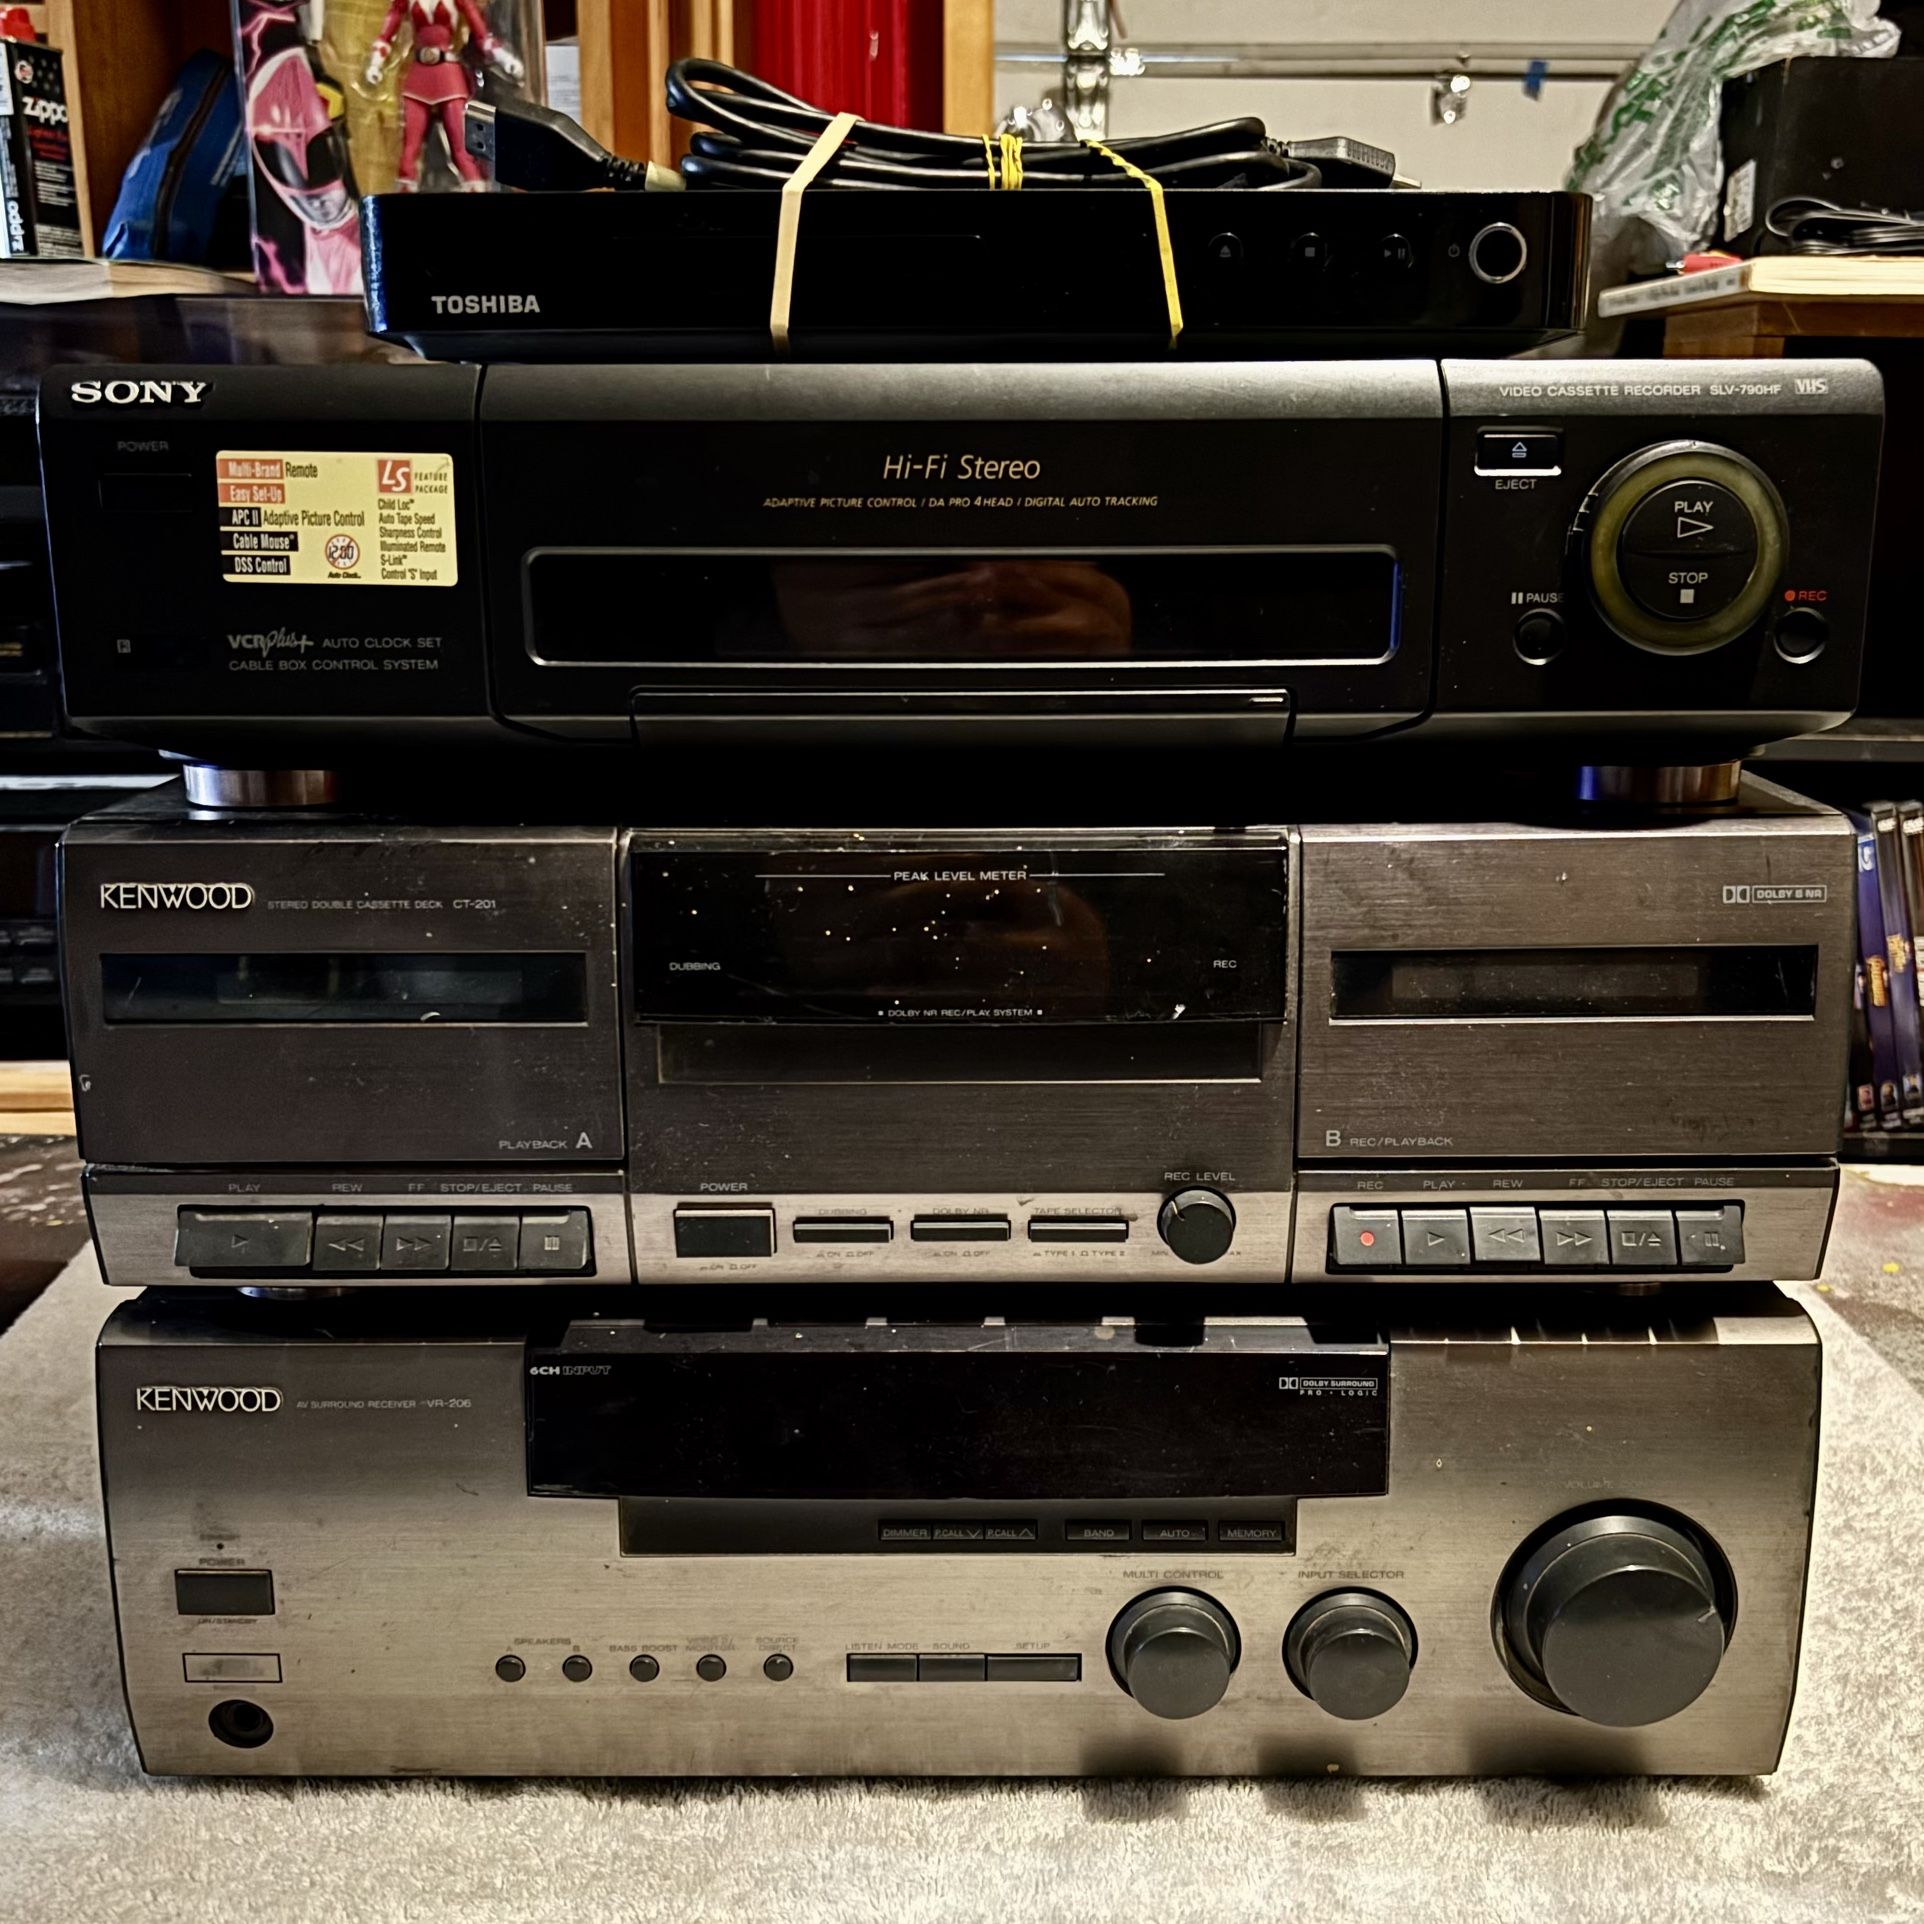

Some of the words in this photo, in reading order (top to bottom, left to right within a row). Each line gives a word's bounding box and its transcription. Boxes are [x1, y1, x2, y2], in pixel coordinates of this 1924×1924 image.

[431, 294, 541, 314] TOSHIBA
[70, 380, 208, 404] SONY
[1500, 386, 1542, 397] VIDEO
[1547, 385, 1619, 397] CASSETTE
[1624, 384, 1701, 396] RECORDER
[1709, 384, 1782, 396] SLV-790HF
[1796, 379, 1827, 394] VHS
[117, 440, 170, 452] POWER
[227, 461, 281, 478] Multi-Brand
[285, 461, 319, 478] Remote
[883, 454, 948, 479] Hi-Fi
[957, 455, 1041, 479] Stereo
[382, 460, 411, 492] LS
[413, 471, 448, 482] FEATURE
[414, 484, 449, 494] PACKAGE
[1494, 478, 1537, 491] EJECT
[229, 485, 251, 503] Easy
[252, 485, 283, 503] Set-Up
[377, 499, 396, 511] Child
[763, 497, 816, 508] ADAPTIVE
[819, 497, 863, 508] PICTURE
[866, 497, 917, 508] CONTROL
[928, 497, 945, 508] DA
[948, 497, 972, 508] PRO
[1024, 496, 1065, 508] DIGITAL
[1069, 496, 1101, 507] AUTO
[1104, 495, 1159, 507] TRACKING
[1674, 500, 1714, 514] PLAY
[231, 508, 250, 526] APC
[263, 510, 299, 528] Adaptive
[301, 510, 332, 526] Picture
[333, 510, 365, 526] Control
[378, 513, 395, 525] Auto
[396, 512, 413, 526] Tape
[414, 512, 436, 526] Speed
[379, 526, 415, 540] Sharpness
[416, 526, 443, 539] Control
[233, 532, 259, 549] Cable
[420, 540, 447, 553] Remote
[234, 556, 253, 573] DSS
[255, 557, 287, 573] Control
[381, 567, 406, 580] Control
[1667, 571, 1709, 585] STOP
[1797, 590, 1828, 602] REC
[322, 637, 360, 649] AUTO
[364, 637, 413, 649] CLOCK
[416, 637, 443, 648] SET
[229, 659, 274, 671] CABLE
[278, 659, 307, 671] BOX
[312, 659, 379, 671] CONTROL
[383, 659, 439, 671] SYSTEM
[893, 871, 930, 881] PEAK
[934, 871, 976, 881] LEVEL
[979, 870, 1028, 881] METER
[100, 883, 254, 909] KENWOOD
[1756, 888, 1793, 900] DOLBY
[1804, 888, 1822, 899] NR
[267, 900, 309, 910] STEREO
[312, 900, 353, 910] DOUBLE
[356, 900, 410, 910] CASSETTE
[414, 900, 443, 910] DECK
[452, 899, 497, 910] CT-201
[668, 961, 722, 972] DUBBING
[1213, 959, 1238, 969] REC
[887, 1009, 921, 1017] DOLBY
[923, 1009, 938, 1017] NR
[940, 1009, 990, 1017] REC/PLAY
[993, 1008, 1033, 1017] SYSTEM
[498, 1140, 569, 1150] PLAYBACK
[575, 1131, 593, 1150] A
[1325, 1129, 1342, 1147] B
[1349, 1136, 1454, 1147] REC/PLAYBACK
[1163, 1171, 1191, 1182] REC
[1195, 1171, 1236, 1182] LEVEL
[228, 1182, 261, 1193] PLAY
[332, 1182, 364, 1193] REW
[408, 1182, 426, 1193] FF
[439, 1182, 523, 1193] STOP/EJECT
[532, 1182, 573, 1193] PAUSE
[700, 1182, 749, 1192] POWER
[1356, 1181, 1385, 1192] REC
[1422, 1179, 1456, 1190] PLAY
[1492, 1179, 1524, 1190] REW
[1568, 1179, 1586, 1188] FF
[1601, 1177, 1684, 1188] STOP/EJECT
[1694, 1177, 1735, 1188] PAUSE
[1033, 1207, 1061, 1216] TAPE
[1063, 1206, 1123, 1216] SELECTOR
[529, 1366, 561, 1376] 6CH
[562, 1365, 612, 1376] INPUT
[1303, 1380, 1329, 1388] DOLBY
[1330, 1380, 1375, 1388] SURROUND
[136, 1387, 284, 1413] KENWOOD
[310, 1400, 365, 1409] SURROUND
[368, 1400, 417, 1409] RECEIVER
[425, 1399, 472, 1409] VR-206
[883, 1528, 928, 1538] DIMMER
[1084, 1528, 1115, 1538] BAND
[1160, 1528, 1190, 1538] AUTO
[1227, 1528, 1277, 1538] MEMORY
[1123, 1570, 1159, 1580] MULTI
[1163, 1570, 1224, 1580] CONTROL
[1298, 1570, 1336, 1580] INPUT
[1339, 1570, 1404, 1580] SELECTOR
[514, 1637, 571, 1646] SPEAKERS
[845, 1642, 882, 1650] LISTEN
[887, 1642, 918, 1650] MODE
[932, 1642, 970, 1650] SOUND
[1015, 1642, 1050, 1650] SETUP
[609, 1645, 638, 1653] BASS
[641, 1645, 678, 1653] BOOST
